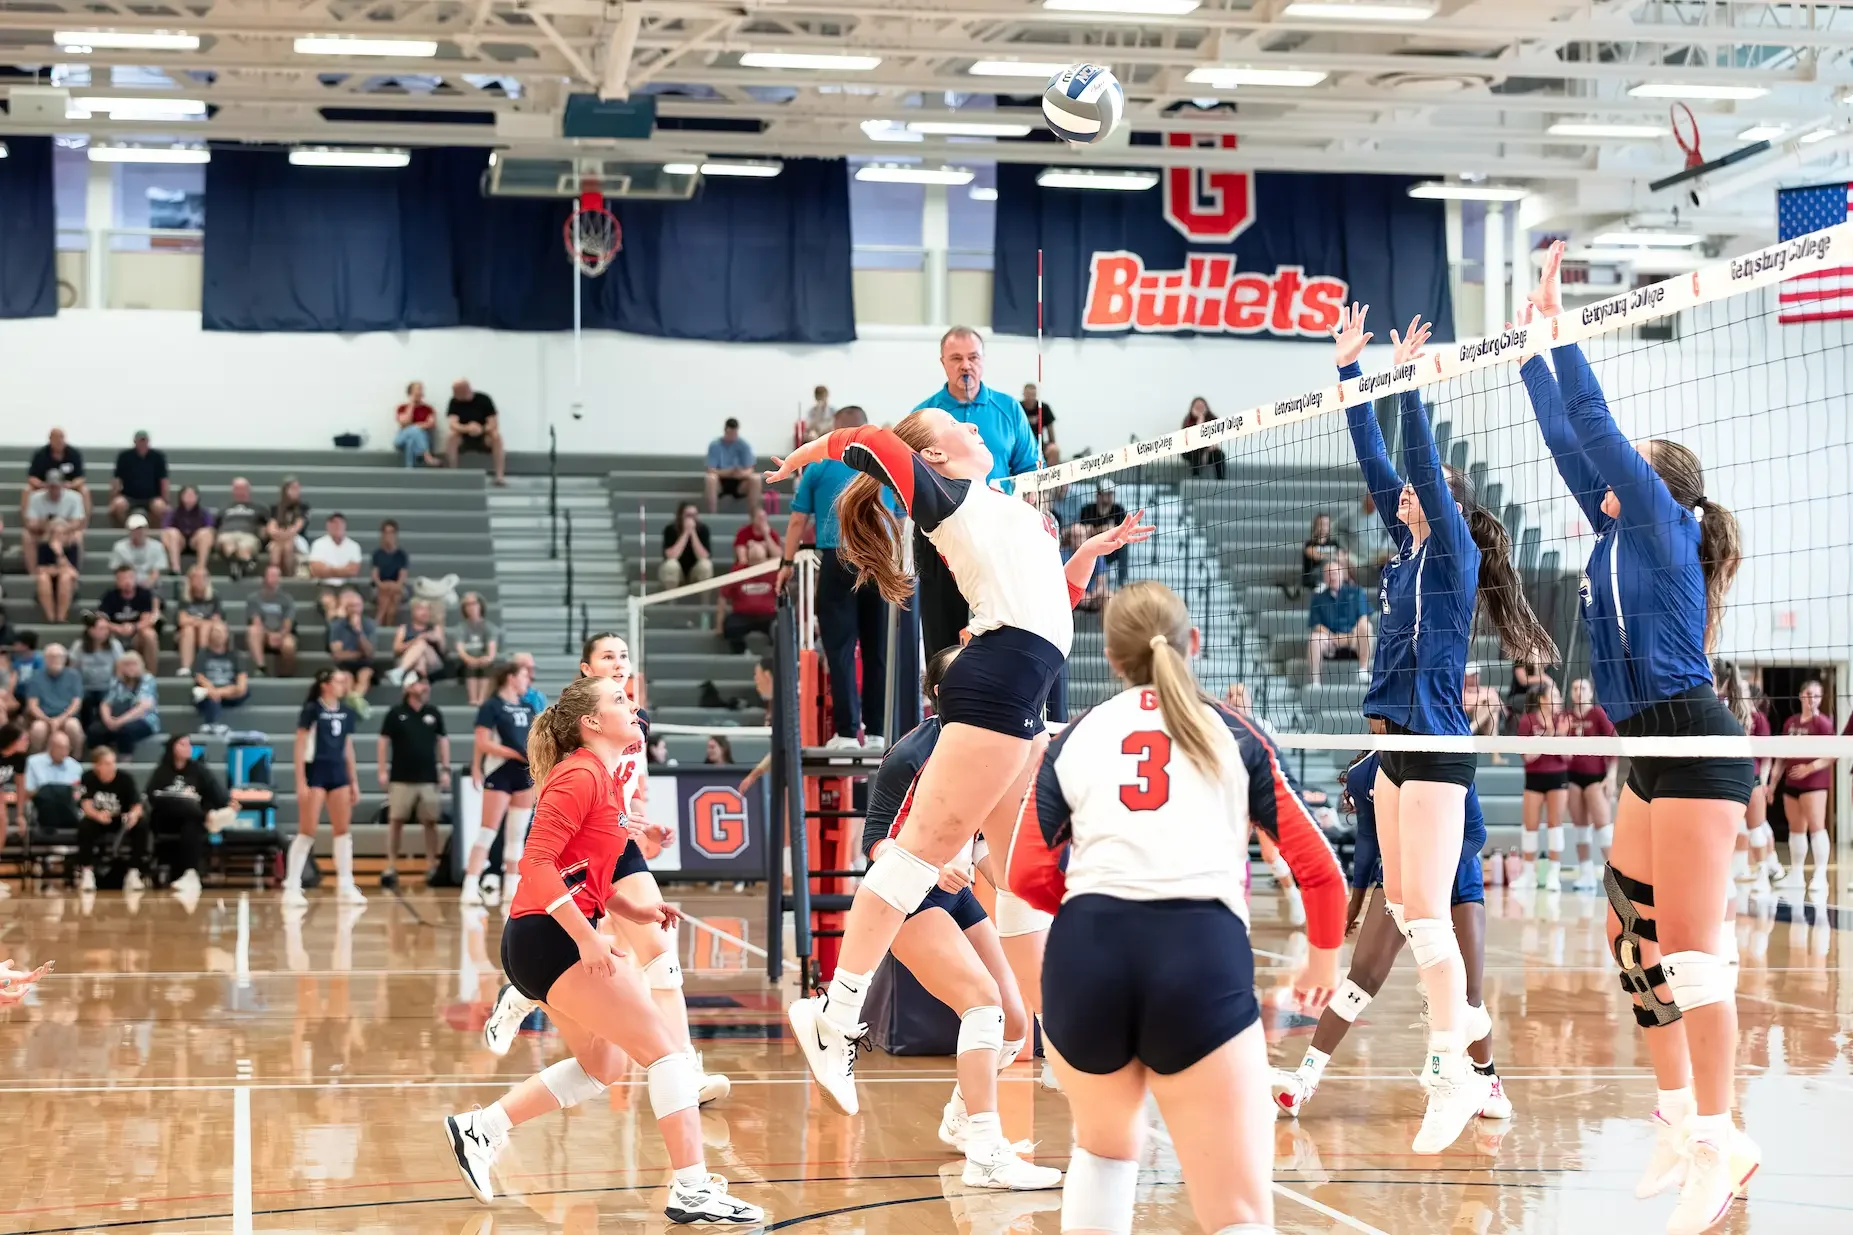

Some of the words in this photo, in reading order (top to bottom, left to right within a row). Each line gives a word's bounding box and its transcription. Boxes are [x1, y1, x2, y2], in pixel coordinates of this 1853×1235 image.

[1730, 249, 1786, 281] Gettysburg
[1788, 234, 1831, 262] College
[1082, 250, 1350, 337] Bullets
[1582, 298, 1627, 326] Gettysburg
[1630, 286, 1665, 311] College
[1459, 336, 1500, 363] Gettysburg
[1500, 328, 1527, 352] College
[1119, 730, 1172, 812] 3
[689, 786, 750, 860] G
